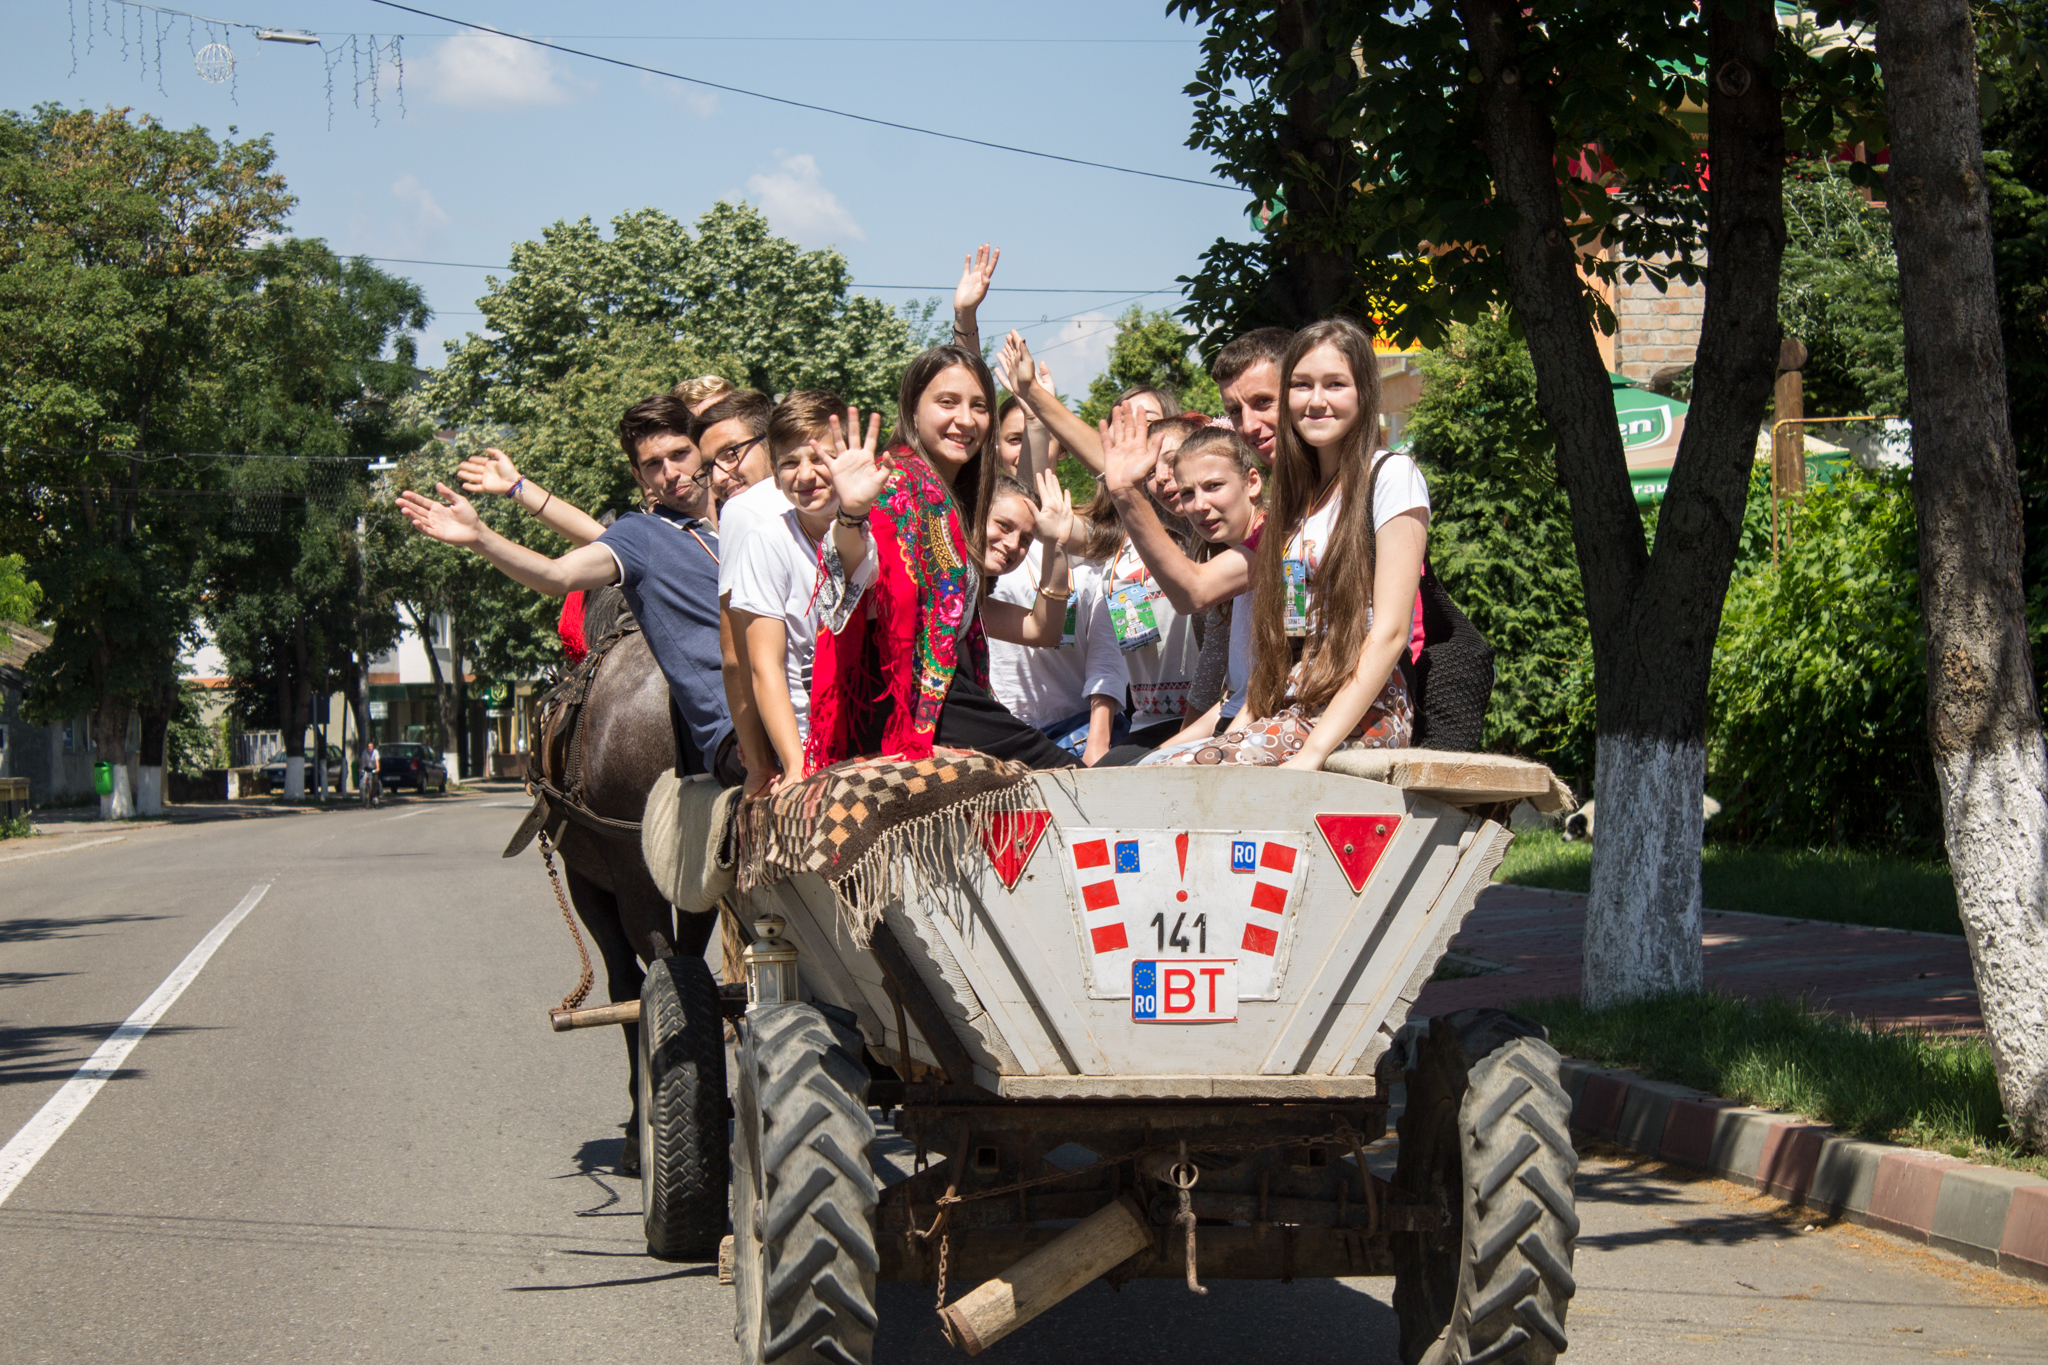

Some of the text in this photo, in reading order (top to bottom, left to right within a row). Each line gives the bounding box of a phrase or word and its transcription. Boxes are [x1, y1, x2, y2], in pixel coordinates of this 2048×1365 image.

[1234, 845, 1254, 863] RO
[1150, 912, 1206, 953] 141
[1135, 968, 1224, 1013] RO BT
